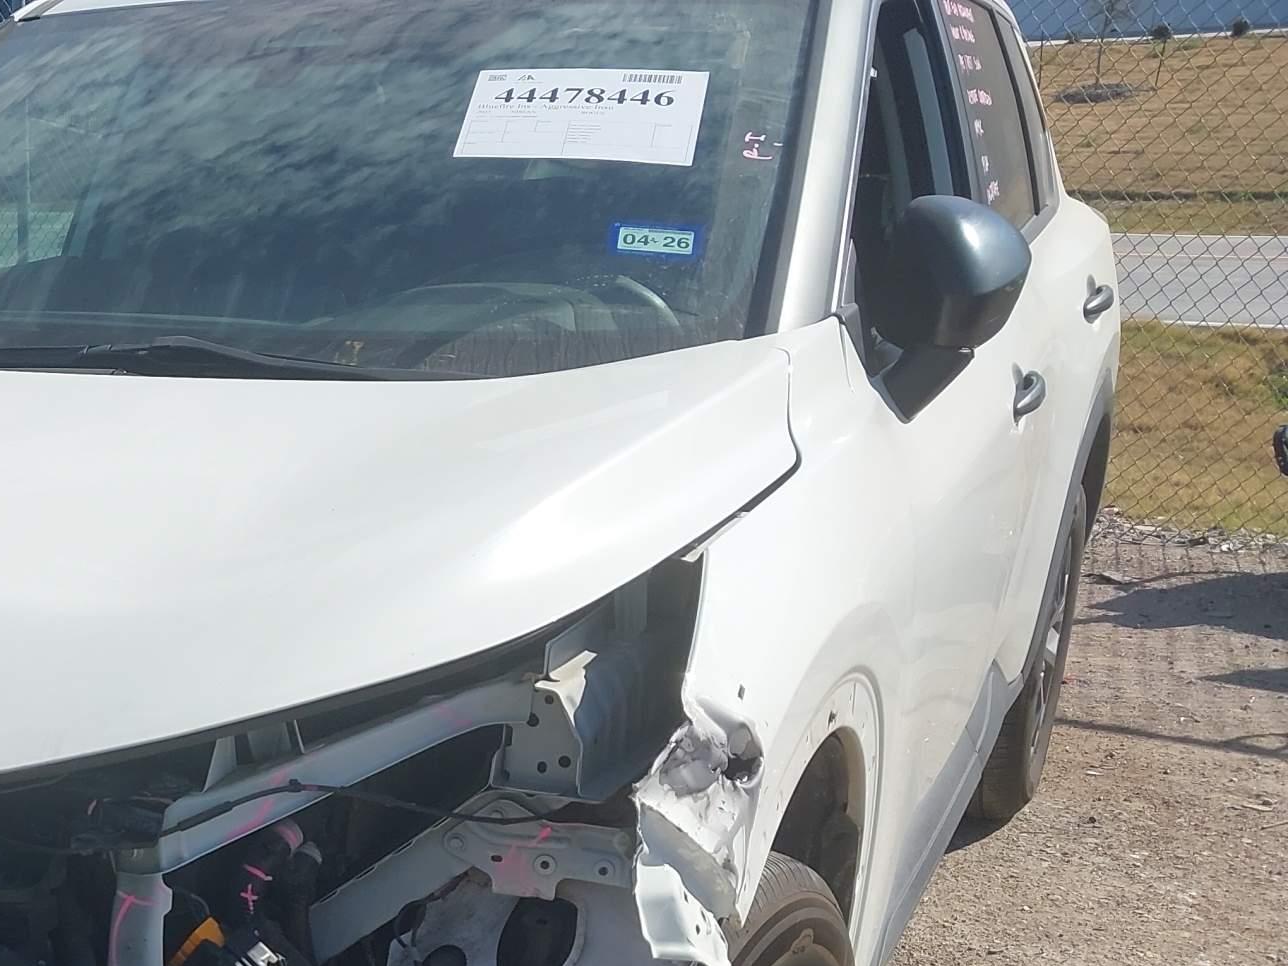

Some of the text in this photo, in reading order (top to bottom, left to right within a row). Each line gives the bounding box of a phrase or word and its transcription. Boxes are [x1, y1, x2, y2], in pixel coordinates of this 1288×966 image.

[494, 87, 675, 107] 44478446
[622, 233, 690, 249] 04 26
